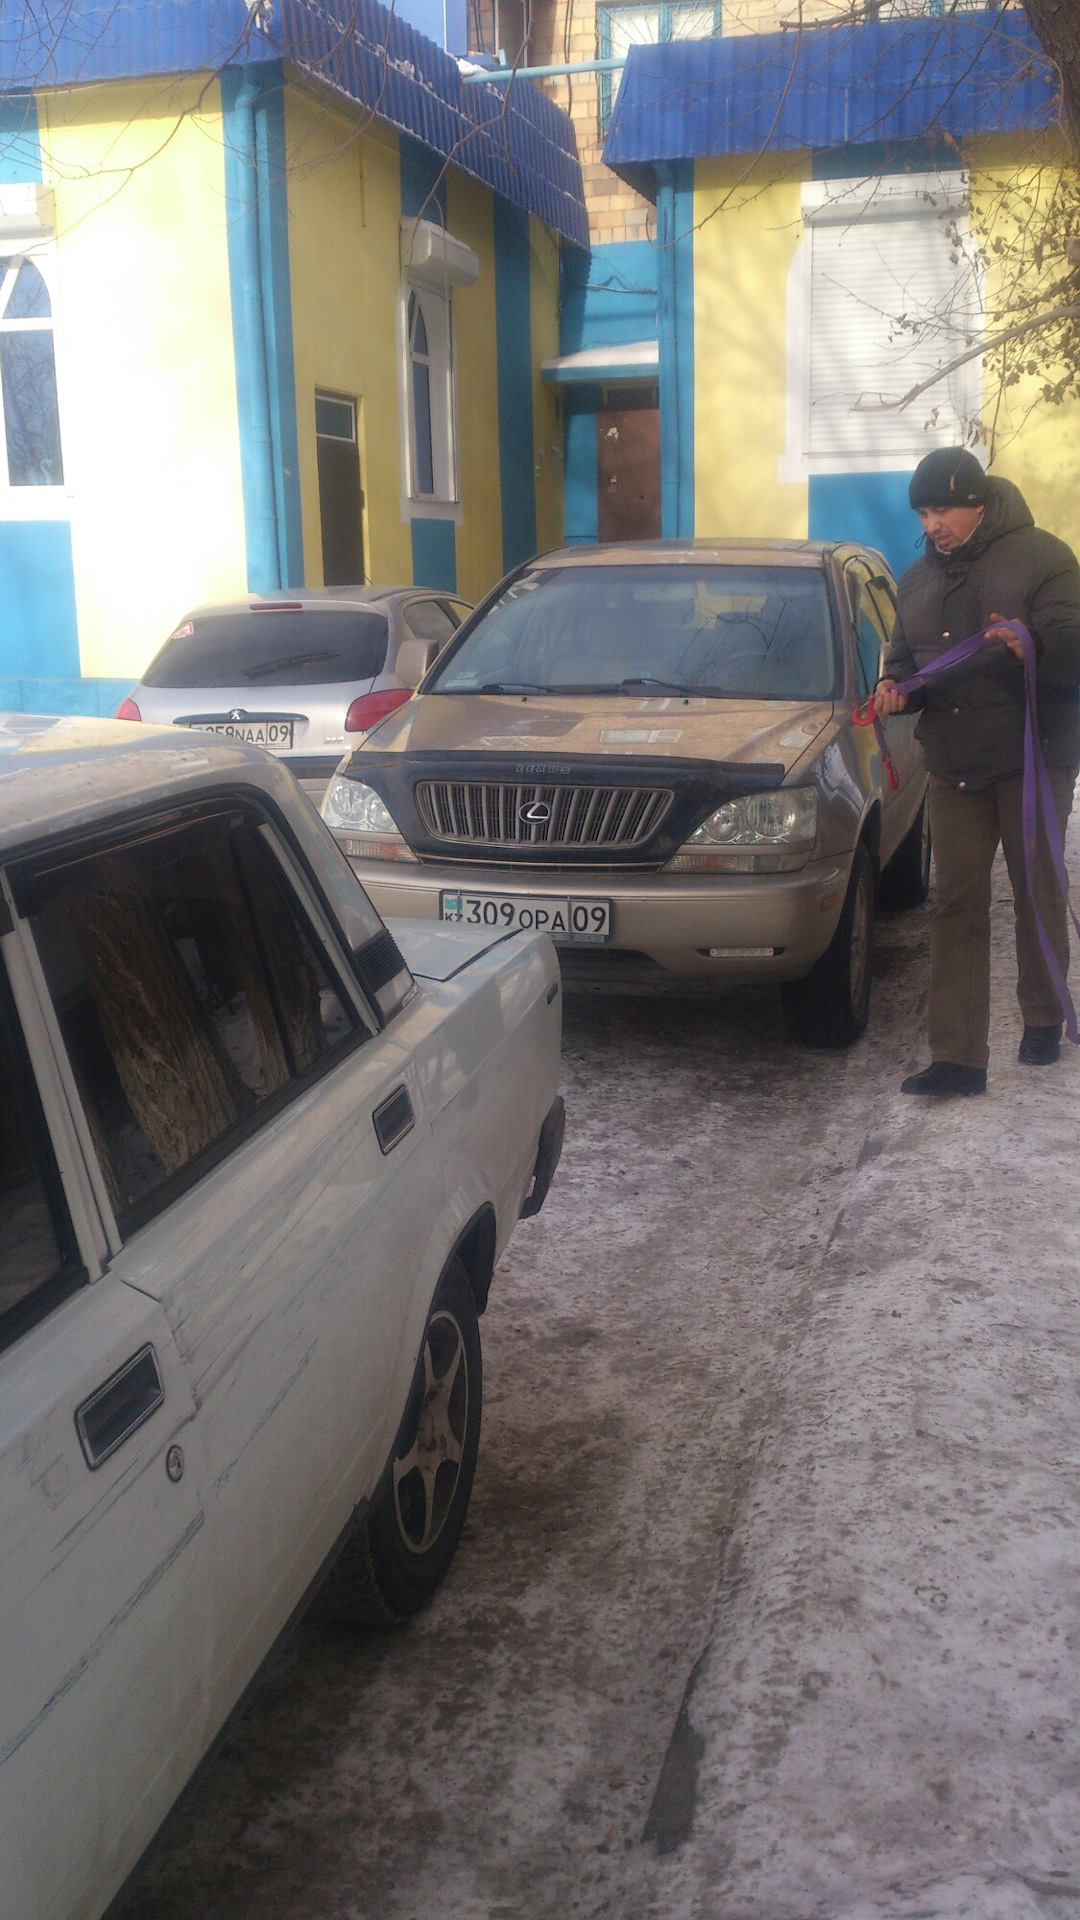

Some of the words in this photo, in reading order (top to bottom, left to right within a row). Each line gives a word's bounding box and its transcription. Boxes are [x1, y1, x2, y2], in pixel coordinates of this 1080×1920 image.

[268, 725, 289, 742] 09
[515, 764, 571, 775] LEXUS
[572, 905, 606, 932] 09
